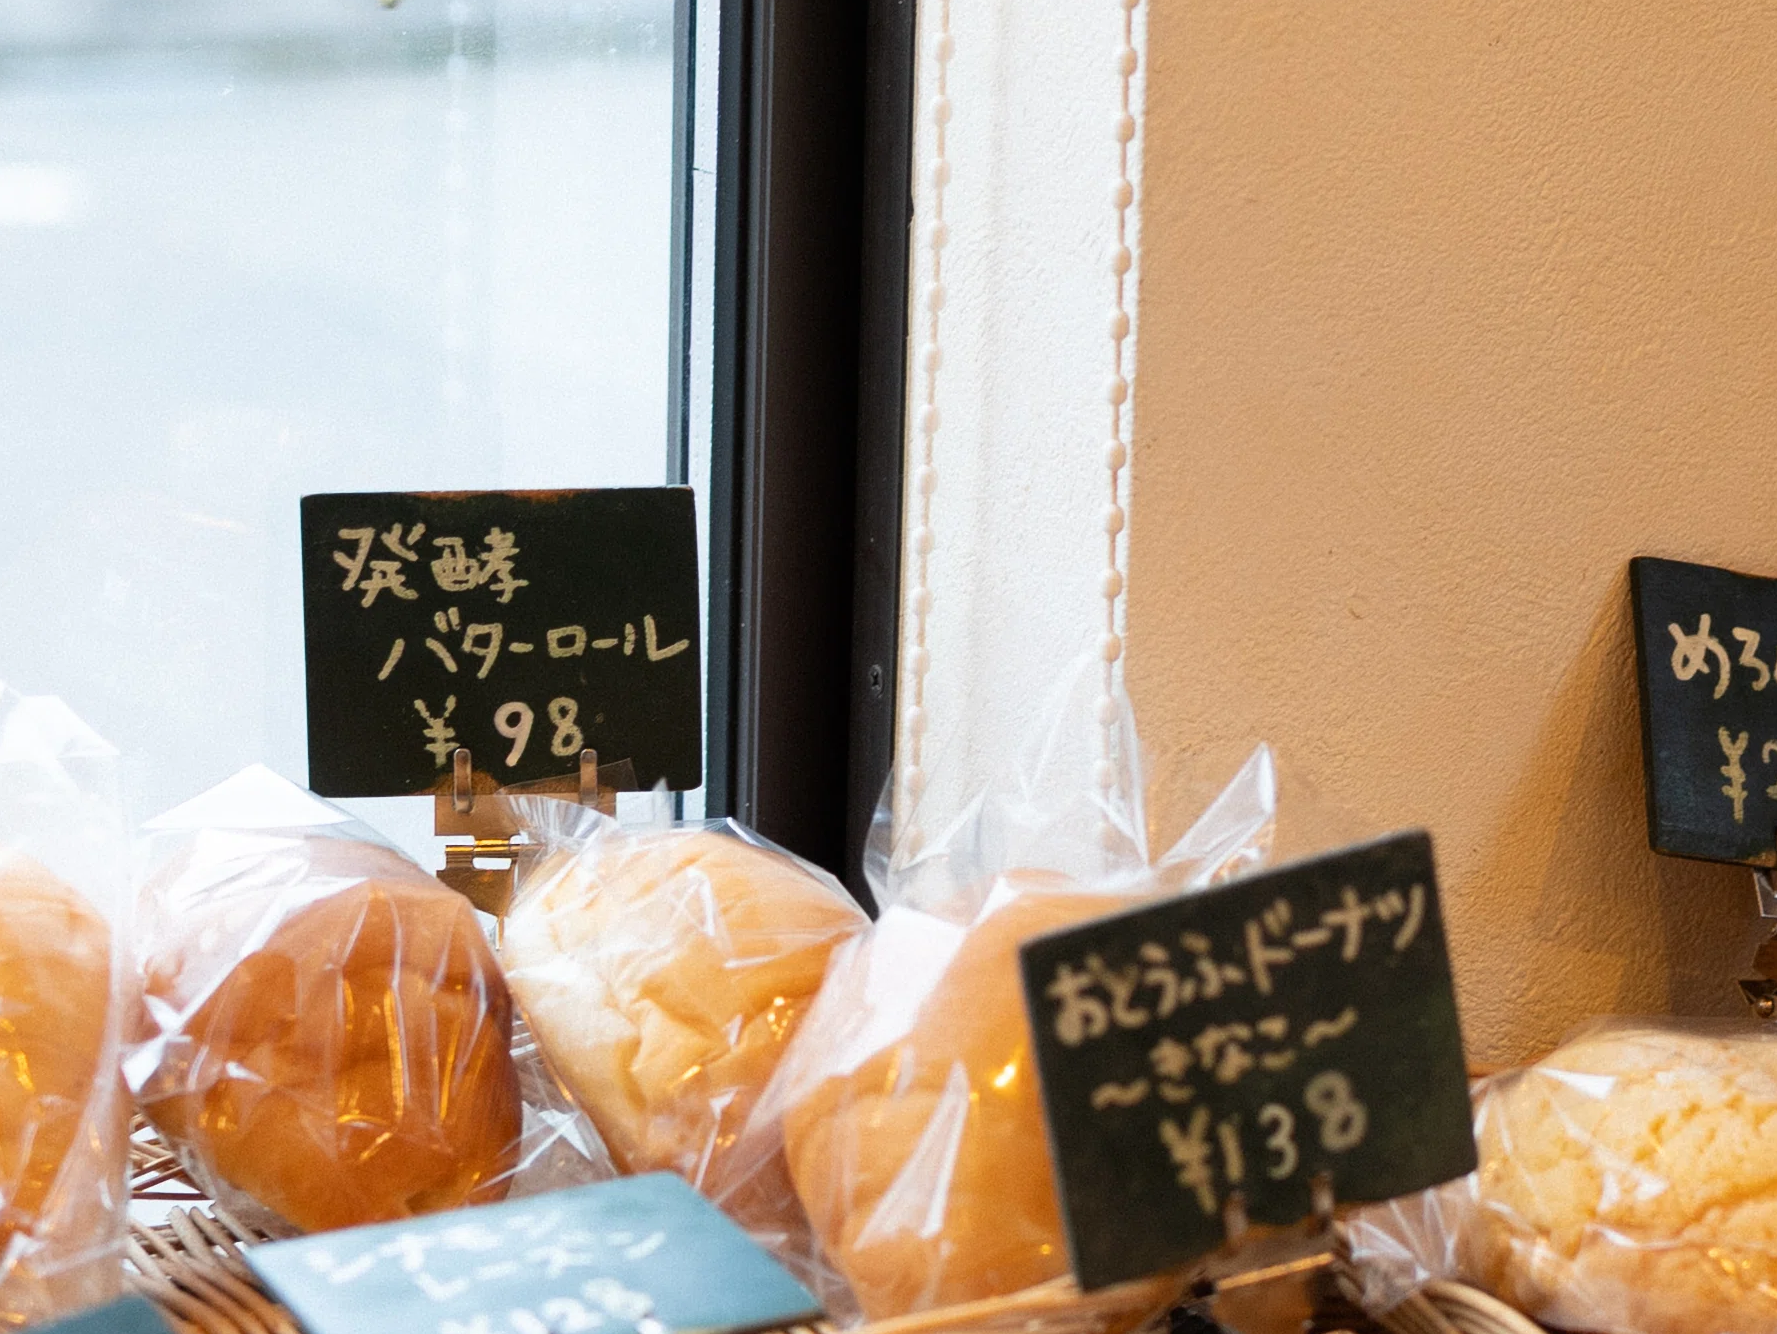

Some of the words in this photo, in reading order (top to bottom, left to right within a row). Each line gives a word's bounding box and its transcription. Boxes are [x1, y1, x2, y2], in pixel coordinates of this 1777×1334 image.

[377, 607, 690, 681] バターロール
[413, 695, 585, 768] ¥98
[1045, 882, 1427, 1047] おとうふドーナツ
[1158, 1070, 1369, 1215] ¥138
